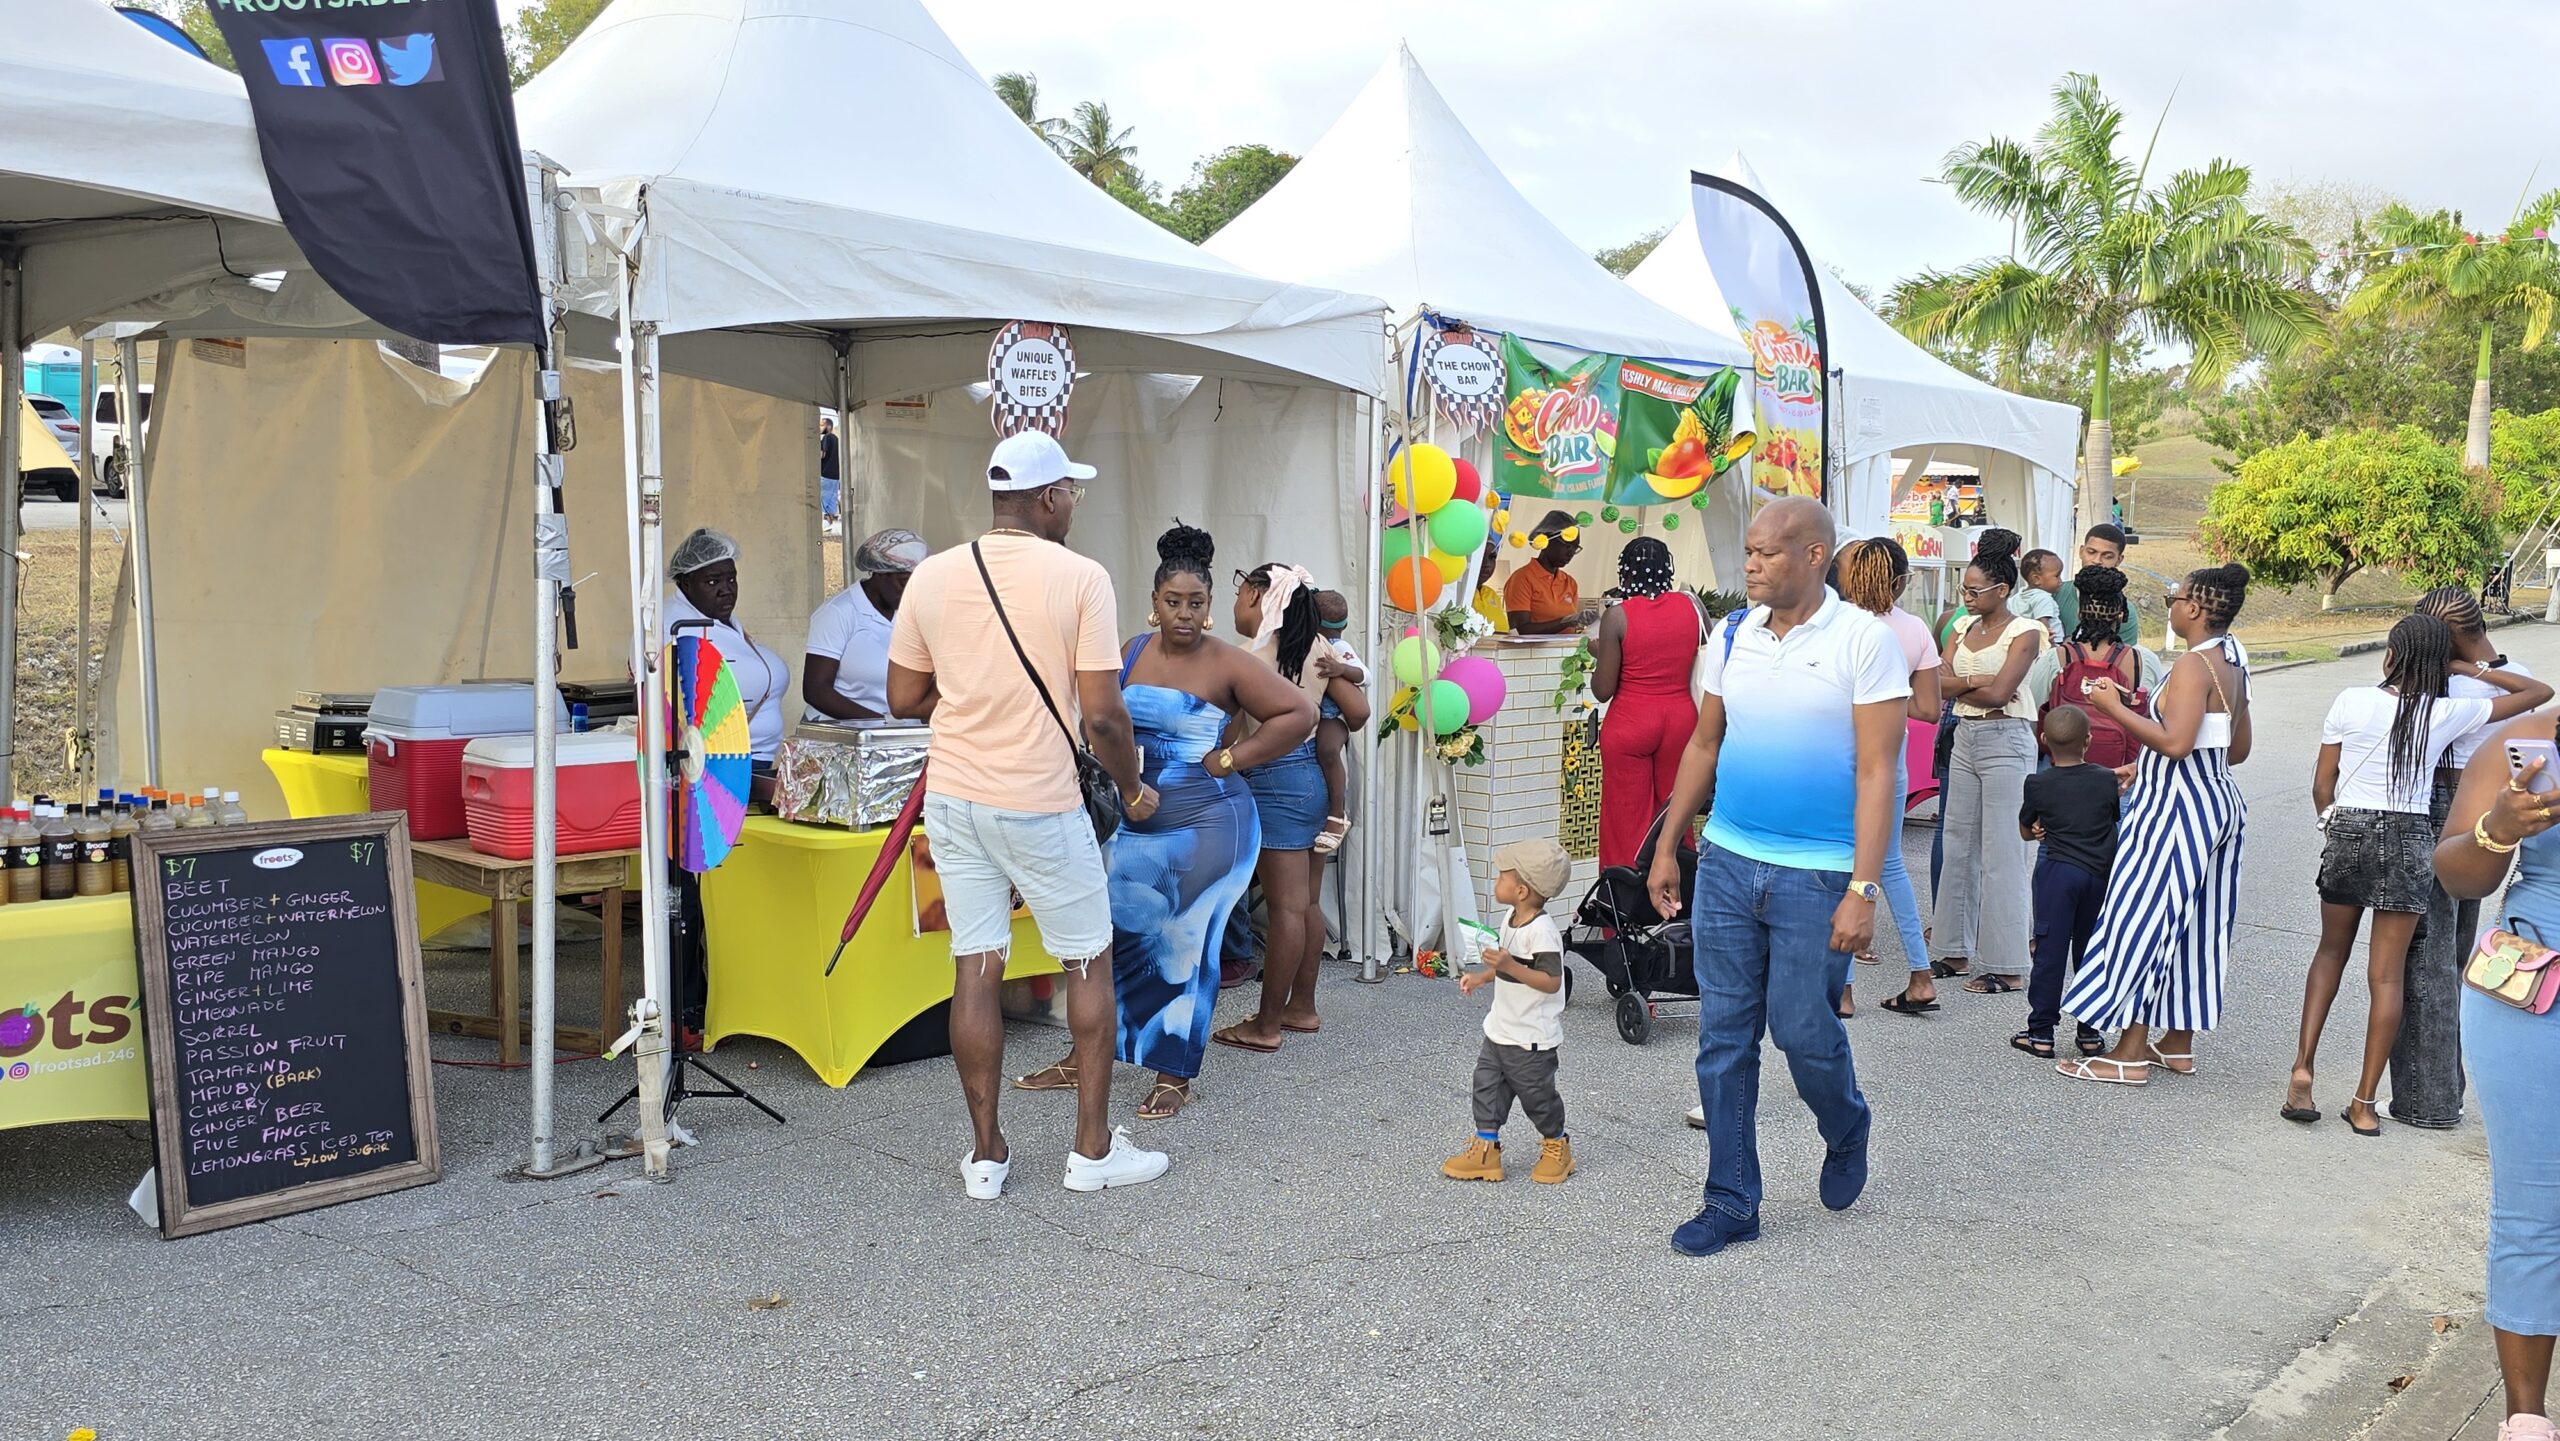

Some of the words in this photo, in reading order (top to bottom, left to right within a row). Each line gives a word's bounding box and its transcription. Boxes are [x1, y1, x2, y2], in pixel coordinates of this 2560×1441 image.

[1016, 351, 1054, 364] UNIQUE
[1437, 361, 1459, 370] THE
[1461, 361, 1491, 372] CHOW
[1011, 368, 1057, 381] WAFFLE'S
[1457, 375, 1478, 385] BAR
[1775, 364, 1810, 393] BAR
[1020, 385, 1047, 397] BITES
[1546, 434, 1594, 468] BAR
[1915, 534, 1943, 558] CORN
[260, 854, 294, 864] froots
[350, 842, 375, 866] $7
[165, 858, 197, 878] $7
[167, 879, 231, 900] BEET
[167, 898, 268, 919] CUCUMBER
[286, 890, 354, 906] GINGER
[168, 914, 266, 936] CUCUMBER
[171, 929, 291, 952] WATERMELON
[173, 951, 236, 971] GREEN
[252, 945, 320, 962] MANGO
[176, 971, 225, 990] RIPE
[250, 964, 314, 981] MANGO
[177, 987, 249, 1006] GINGER
[268, 980, 314, 996] LIME
[179, 1024, 262, 1046] SORREL
[34, 1047, 135, 1075] frootsad.246
[186, 1040, 279, 1065] PASSION
[287, 1034, 346, 1054] FRUIT
[184, 1059, 291, 1086] TAMARIND
[190, 1082, 261, 1105] MAUBY
[266, 1067, 322, 1090] (BARK)
[189, 1097, 270, 1118] CHERRY
[189, 1115, 258, 1137] GINGER
[275, 1102, 325, 1123] BEER
[192, 1135, 239, 1155] FIVE
[262, 1121, 331, 1144] FINGER
[190, 1142, 308, 1176] LEMONGRASS
[321, 1134, 358, 1151] ICED
[366, 1130, 394, 1142] TEA
[312, 1151, 339, 1164] LOW
[347, 1143, 390, 1158] SUGAR
